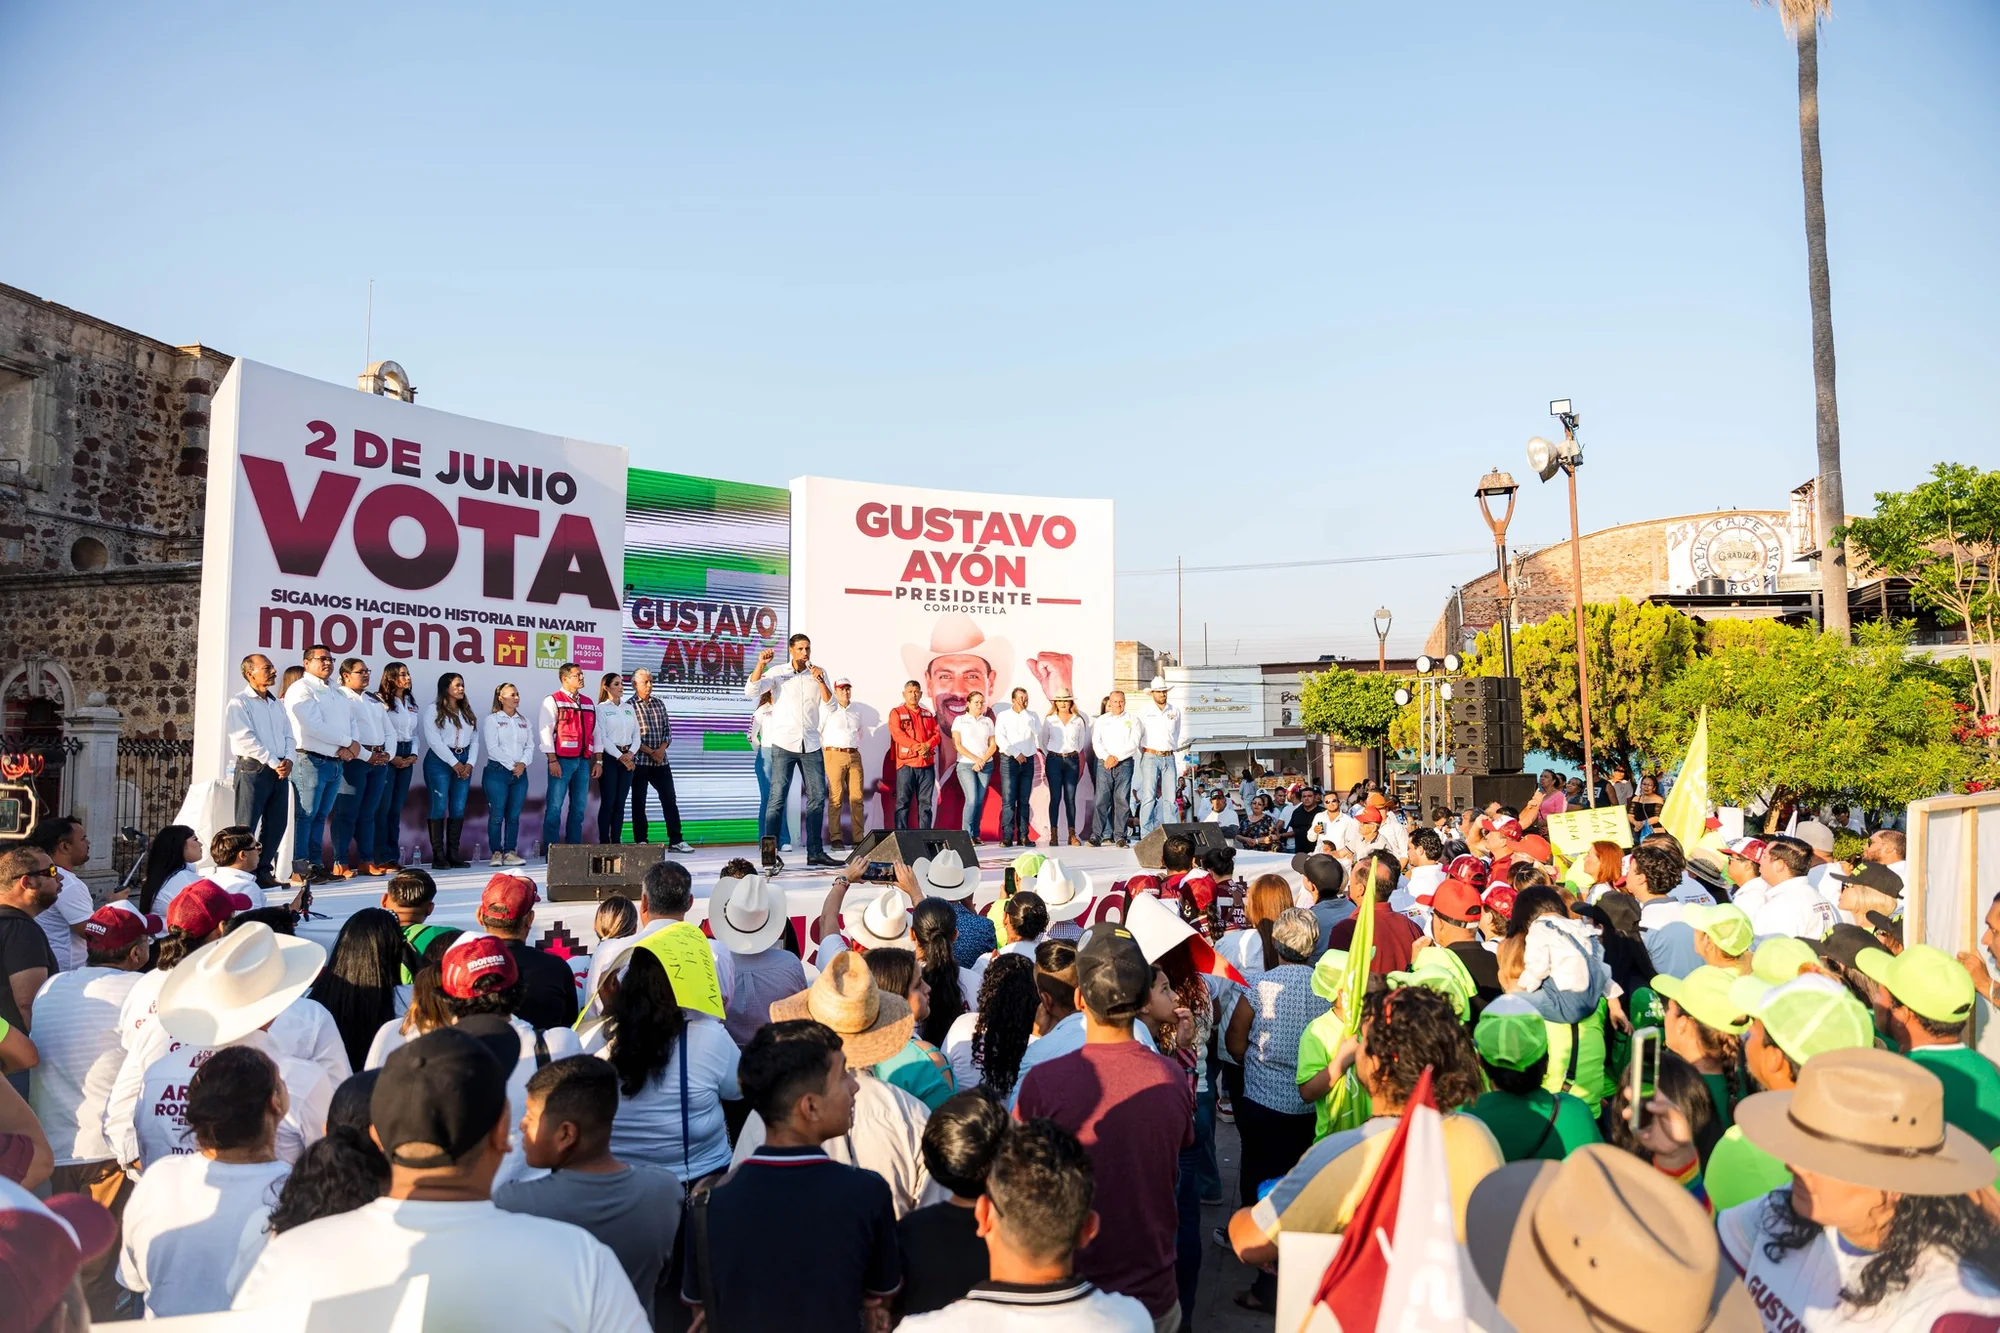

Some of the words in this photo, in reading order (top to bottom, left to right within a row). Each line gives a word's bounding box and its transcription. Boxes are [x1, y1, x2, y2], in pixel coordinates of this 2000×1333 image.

[305, 420, 336, 461] 2
[354, 429, 421, 478] DE
[435, 450, 578, 505] JUNIO
[240, 454, 621, 611] VOTA
[856, 502, 1077, 549] GUSTAVO
[900, 544, 1026, 588] AYÓN
[271, 588, 352, 610] SIGAMOS
[355, 598, 441, 619] HACIENDO
[445, 607, 514, 627] HISTORIA
[517, 615, 536, 629] EN
[539, 618, 597, 634] NAYARIT
[895, 586, 1032, 605] PRESIDENTE
[924, 603, 1007, 615] COMPOSTELA
[258, 606, 486, 664] morena
[632, 598, 778, 638] GUSTAVO
[497, 643, 526, 665] PT
[536, 657, 567, 668] VERDE
[576, 643, 600, 651] FUERZA
[660, 634, 745, 677] AYÓN
[86, 922, 107, 935] orena
[467, 954, 505, 970] morena
